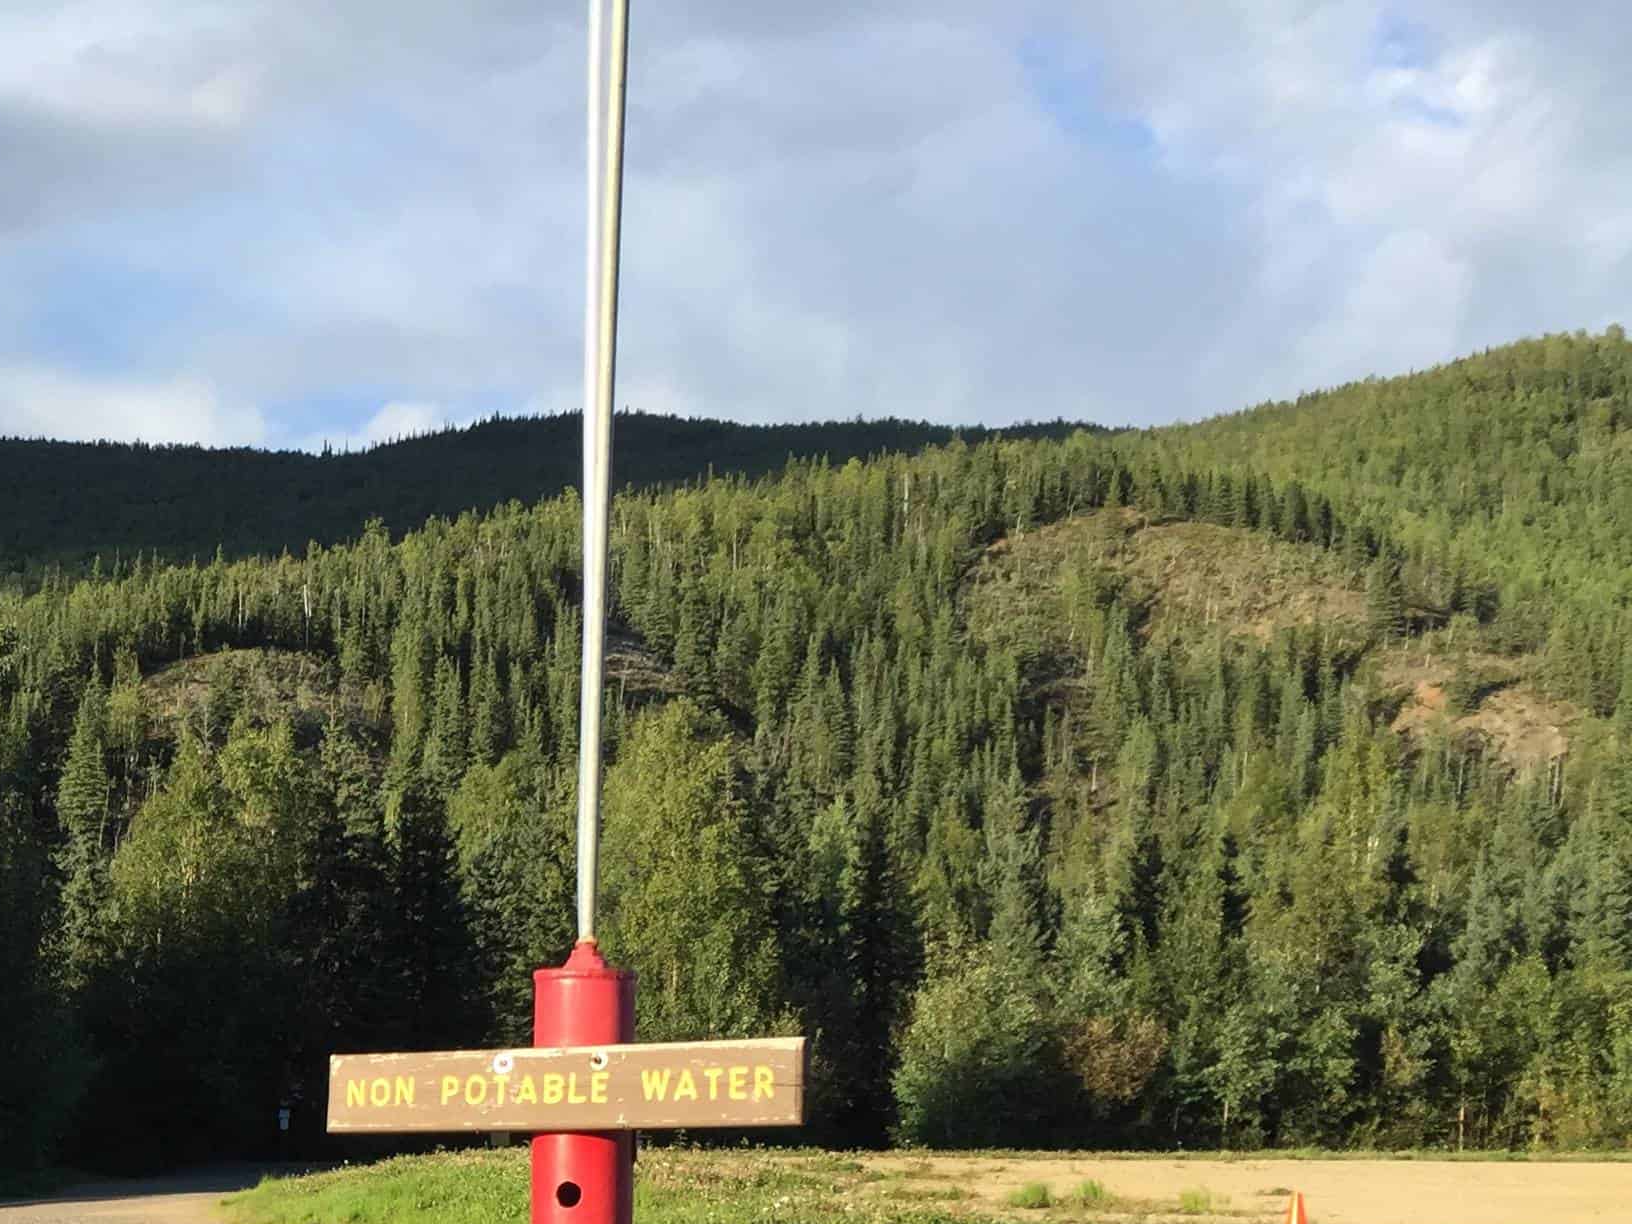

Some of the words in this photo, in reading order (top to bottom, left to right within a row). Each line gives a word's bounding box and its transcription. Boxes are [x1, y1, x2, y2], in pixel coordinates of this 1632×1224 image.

[346, 1076, 416, 1107] NON
[440, 1071, 610, 1106] POTABLE
[641, 1065, 775, 1102] WATER
